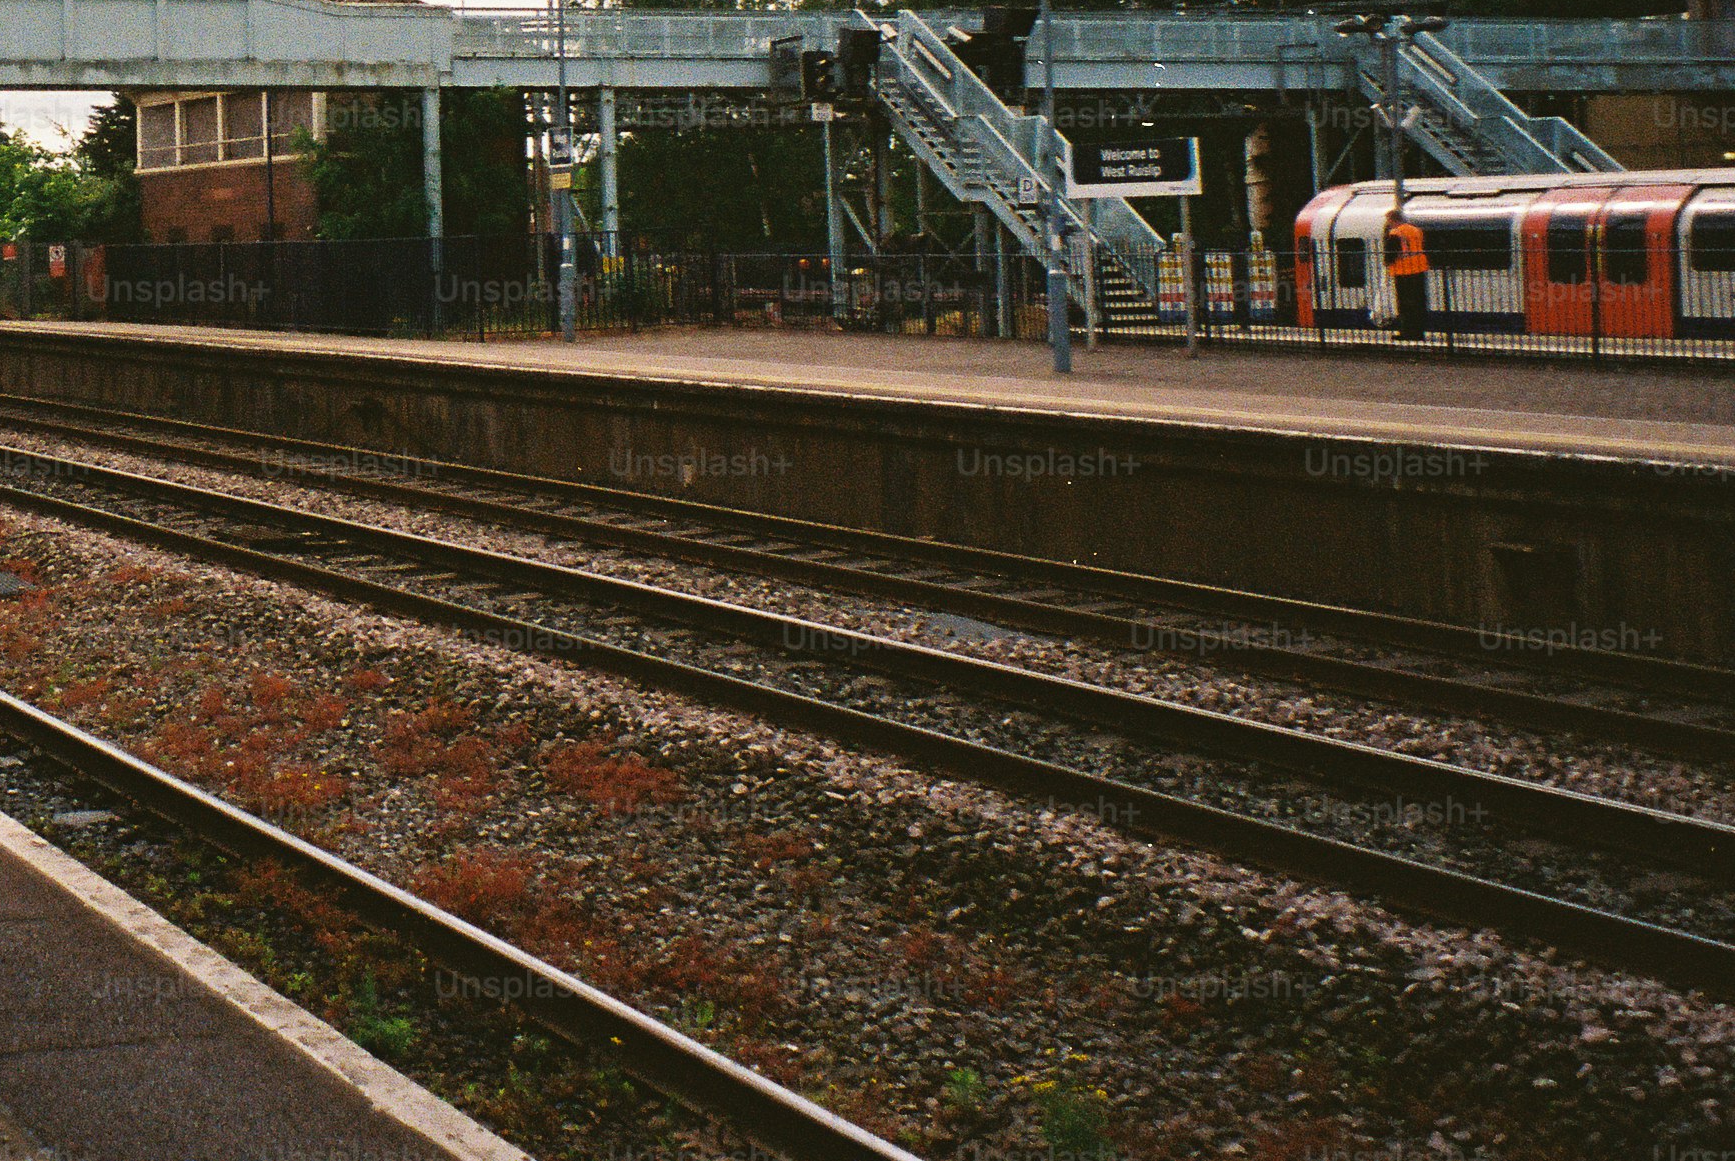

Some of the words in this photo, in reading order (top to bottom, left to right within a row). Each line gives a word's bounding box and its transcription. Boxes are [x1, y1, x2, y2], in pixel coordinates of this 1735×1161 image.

[1100, 148, 1146, 161] Welcome
[1148, 148, 1161, 159] to
[1100, 165, 1126, 178] West
